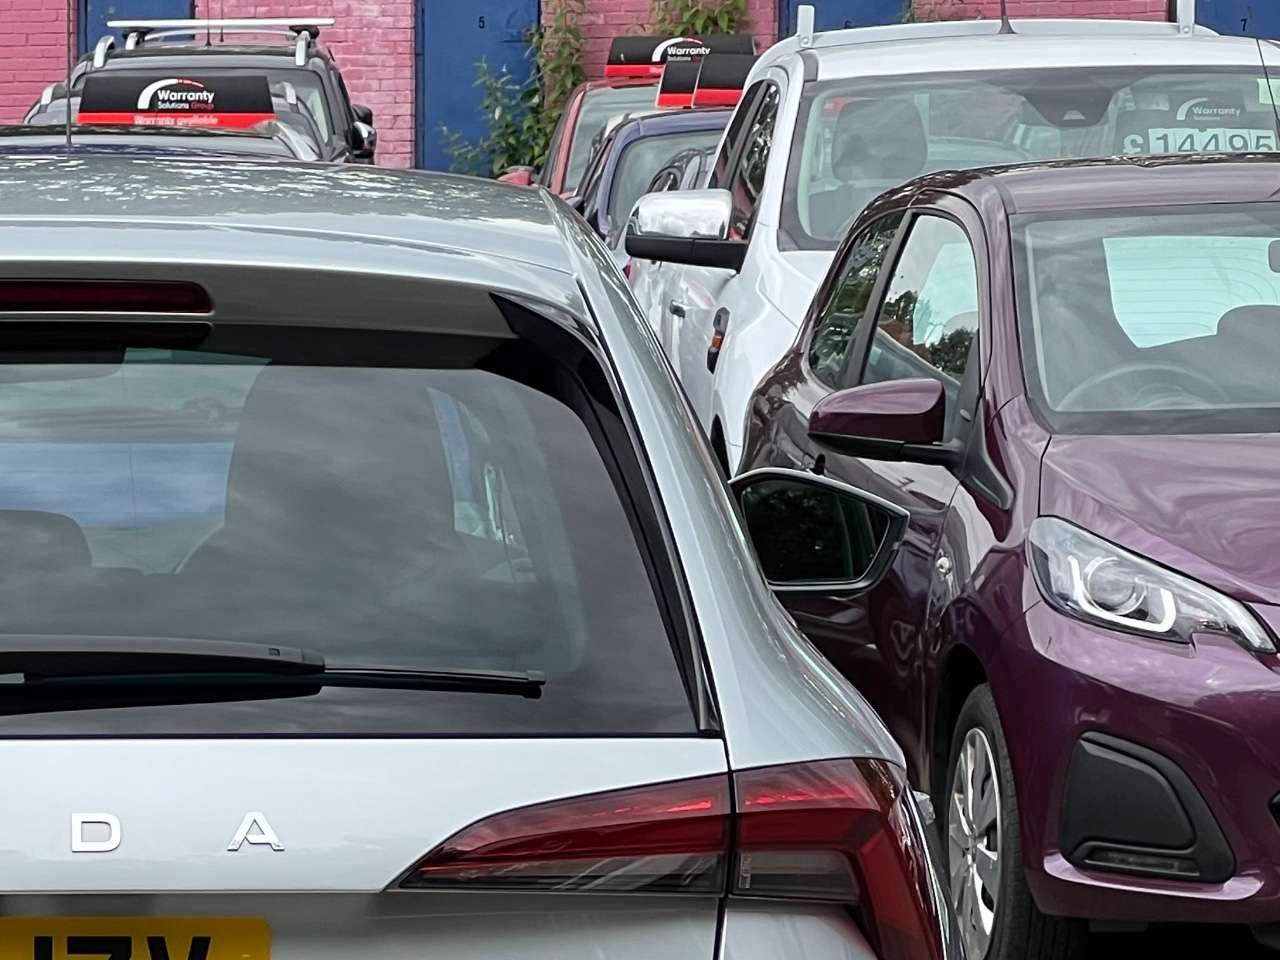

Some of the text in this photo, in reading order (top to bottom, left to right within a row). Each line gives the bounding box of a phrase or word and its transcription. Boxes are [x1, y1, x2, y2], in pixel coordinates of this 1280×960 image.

[478, 15, 485, 29] 5
[1240, 18, 1248, 32] 7
[667, 46, 710, 55] Warranty
[157, 90, 214, 103] Warranty
[157, 102, 214, 111] Solutions Group
[1191, 106, 1241, 117] Warranty
